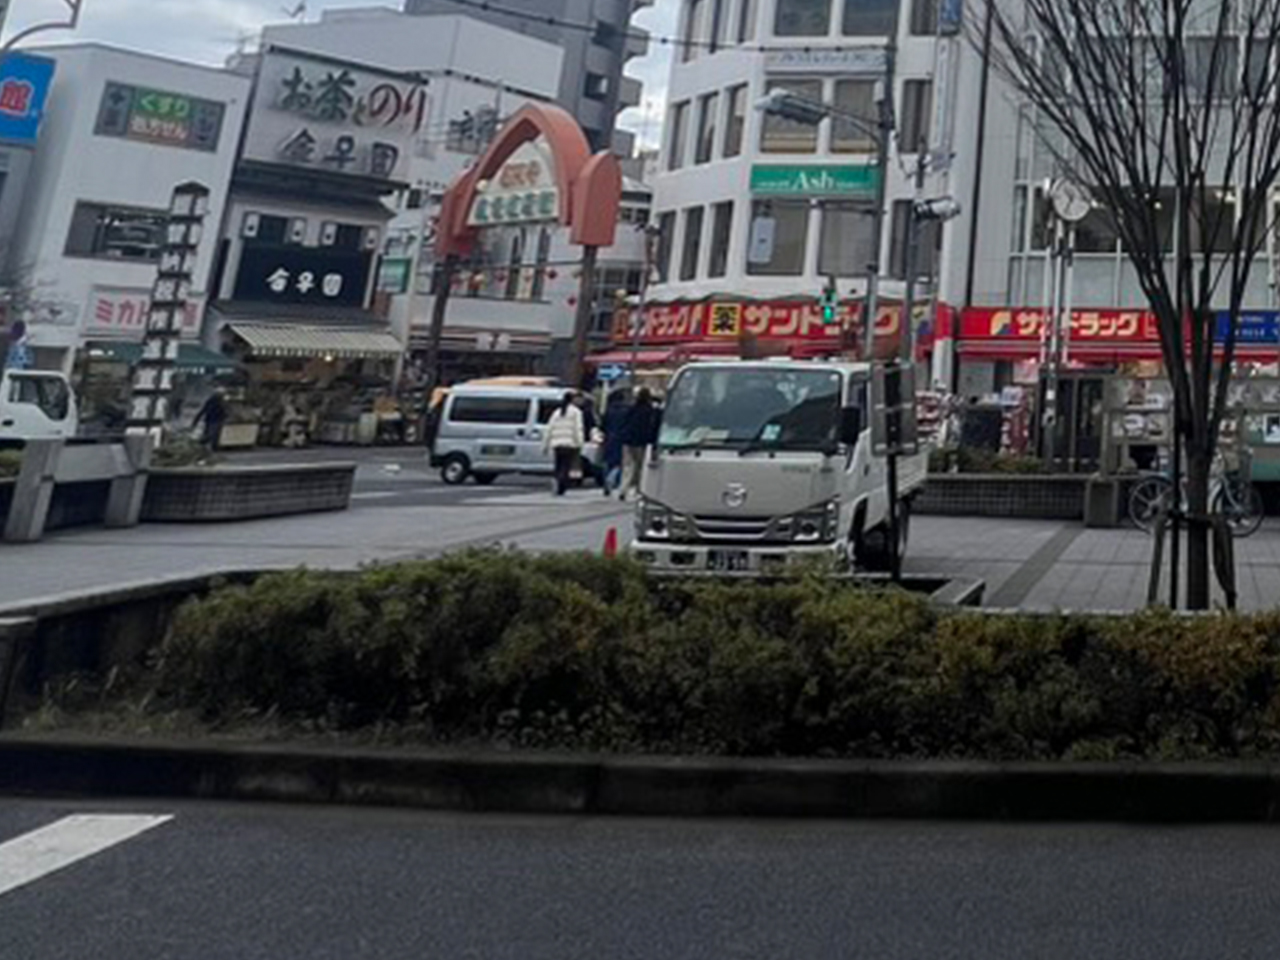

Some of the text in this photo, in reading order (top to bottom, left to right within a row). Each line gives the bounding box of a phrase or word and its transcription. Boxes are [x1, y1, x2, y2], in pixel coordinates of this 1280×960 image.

[140, 92, 190, 118] くすり
[791, 170, 834, 191] Ash
